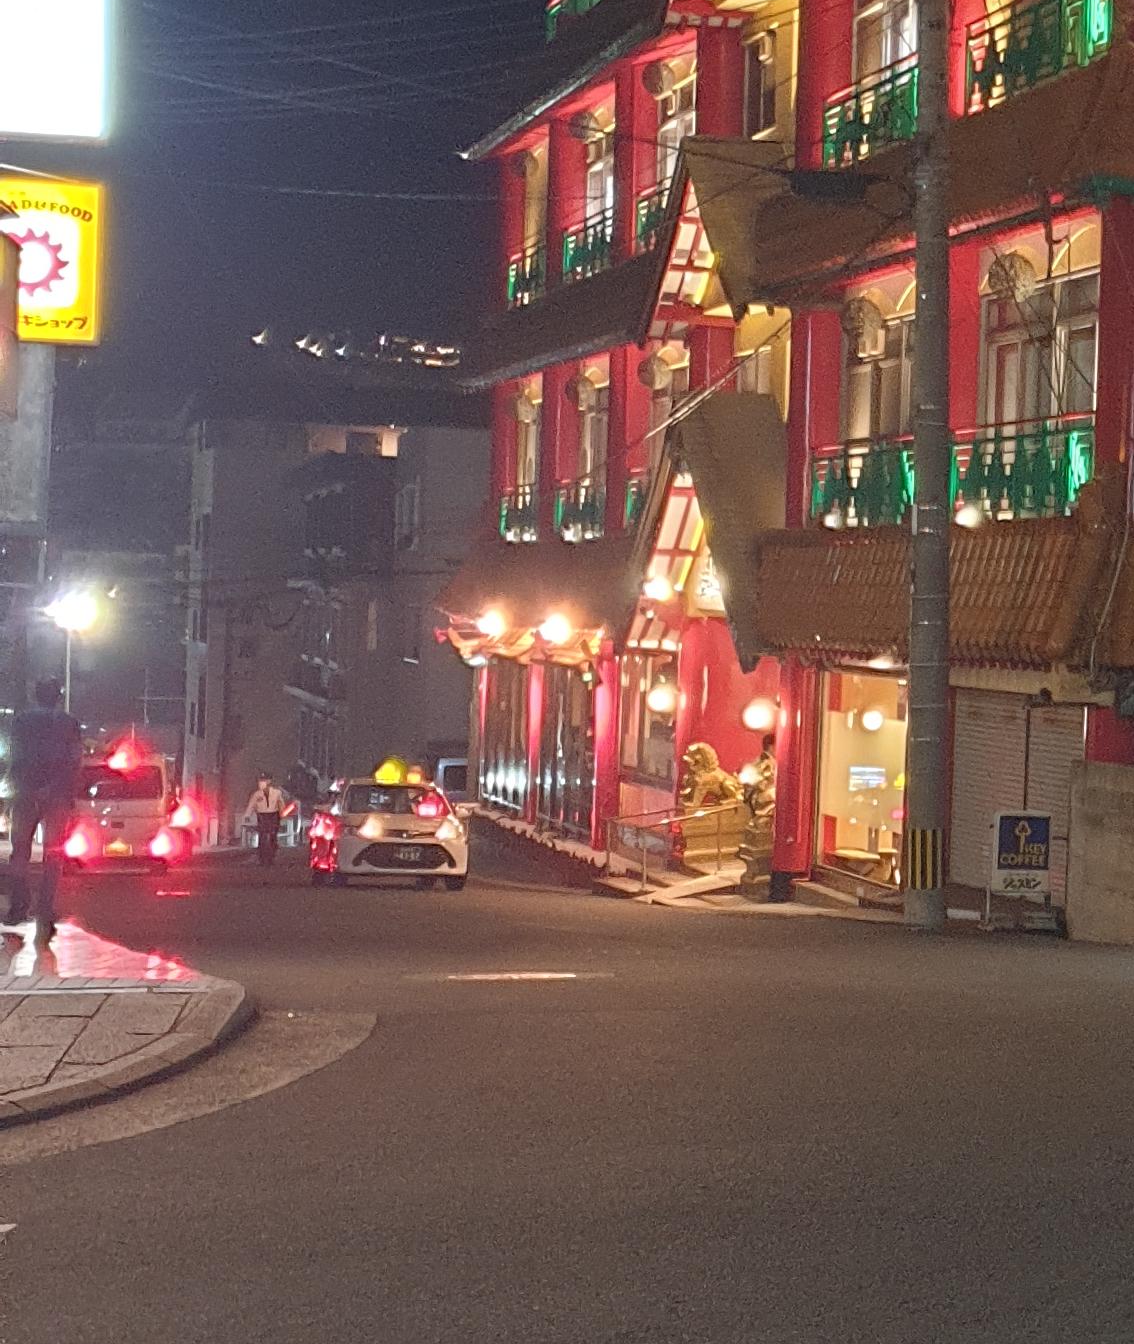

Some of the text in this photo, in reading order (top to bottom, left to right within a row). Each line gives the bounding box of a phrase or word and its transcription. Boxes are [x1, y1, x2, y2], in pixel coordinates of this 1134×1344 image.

[50, 202, 93, 223] FOOD
[19, 314, 88, 330] キショップ
